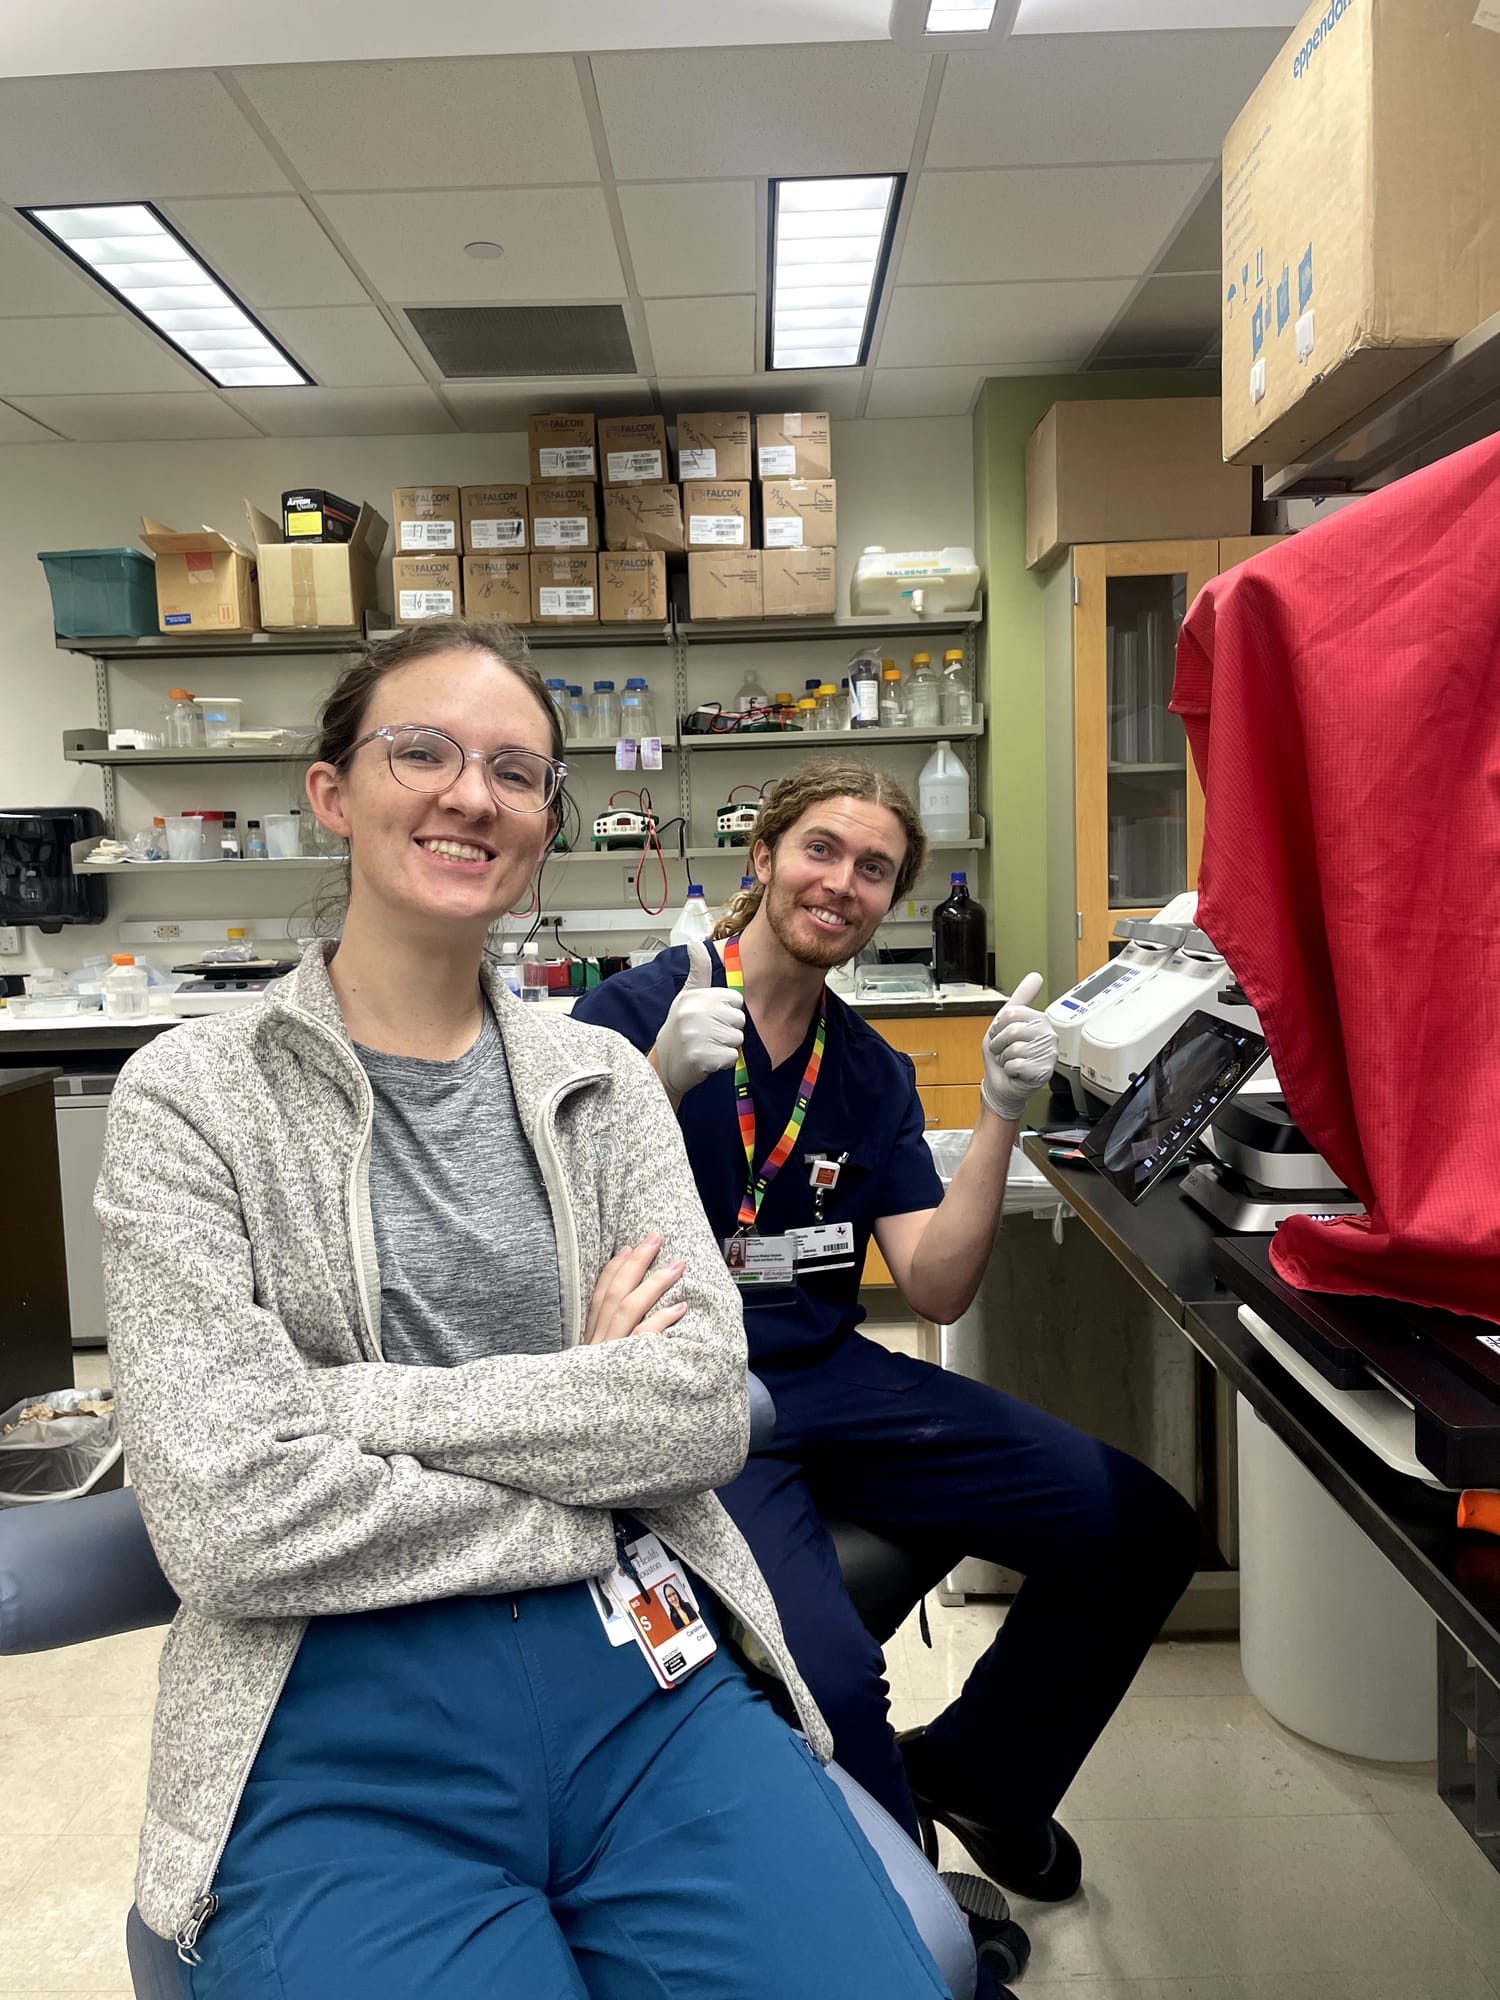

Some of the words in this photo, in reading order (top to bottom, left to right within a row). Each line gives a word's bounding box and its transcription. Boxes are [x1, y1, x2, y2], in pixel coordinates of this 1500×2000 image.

[1294, 0, 1353, 78] eppendo
[550, 419, 584, 428] FALCON
[620, 423, 656, 433] FALCON
[416, 493, 450, 503] FALCON
[483, 492, 518, 501] FALCON
[550, 489, 585, 499] FALCON
[706, 488, 742, 498] FALCON
[415, 563, 450, 573] FALCON
[485, 562, 520, 572] FALCON
[553, 559, 588, 569] FALCON
[620, 559, 654, 568] FALCON
[640, 1615, 652, 1631] S
